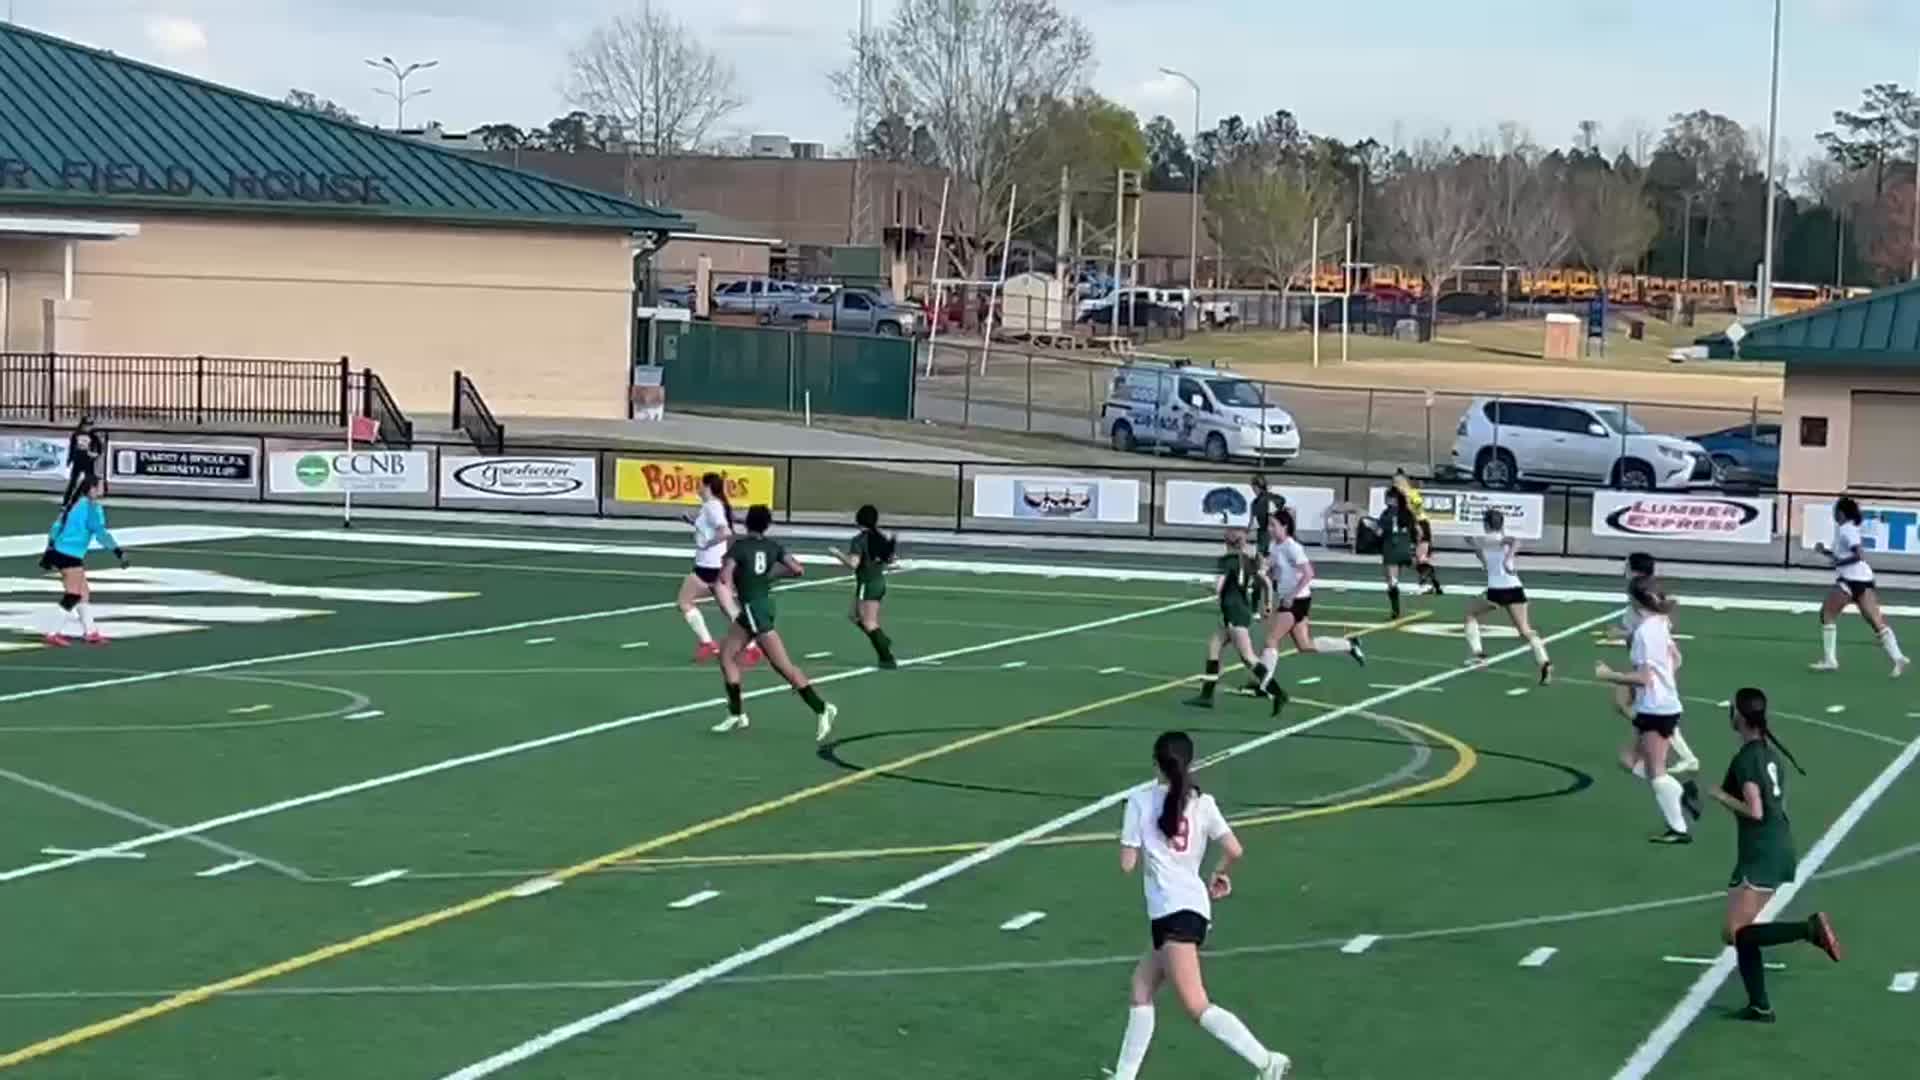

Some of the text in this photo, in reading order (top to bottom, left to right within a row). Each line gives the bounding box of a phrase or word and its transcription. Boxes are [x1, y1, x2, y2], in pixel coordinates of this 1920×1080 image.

[61, 159, 194, 196] FIELD
[228, 169, 389, 205] HOUSE
[332, 453, 405, 475] CCNB
[1630, 500, 1738, 519] LUMBER
[1627, 514, 1737, 532] EXPRESS
[754, 551, 767, 575] 8
